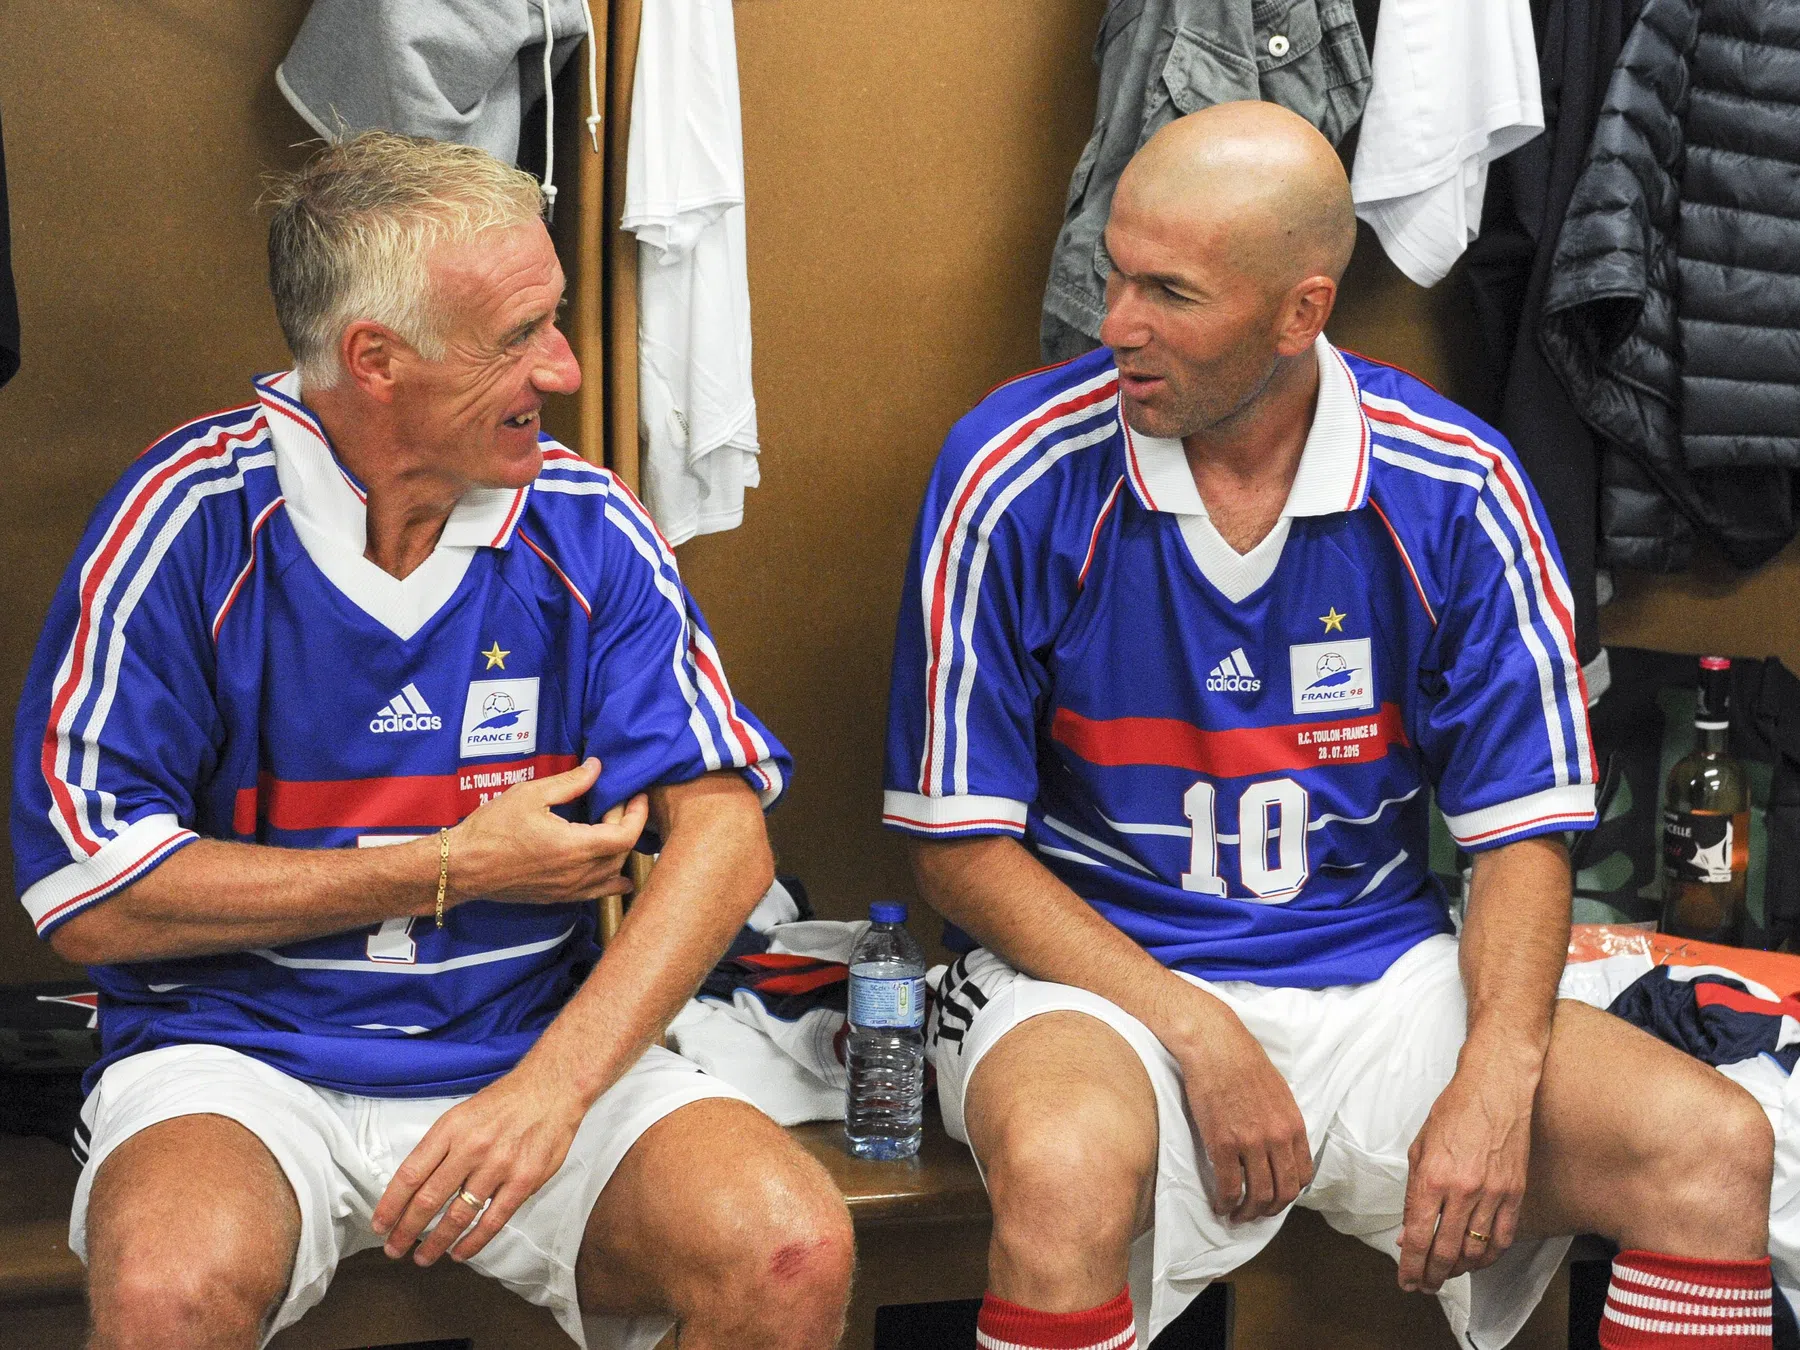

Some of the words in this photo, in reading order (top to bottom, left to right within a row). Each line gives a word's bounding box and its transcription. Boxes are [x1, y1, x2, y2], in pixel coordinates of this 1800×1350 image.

[1206, 675, 1261, 692] adidas
[1300, 690, 1347, 701] FRANCE
[1350, 687, 1364, 697] 98
[369, 712, 442, 734] adidas
[1312, 724, 1369, 743] TOULON-FRANCE
[1369, 722, 1378, 737] 98
[467, 732, 513, 744] FRANCE
[516, 731, 530, 740] 98
[460, 775, 473, 791] R.C.
[473, 767, 528, 789] TOULON-FRANCE
[1181, 777, 1309, 899] 10
